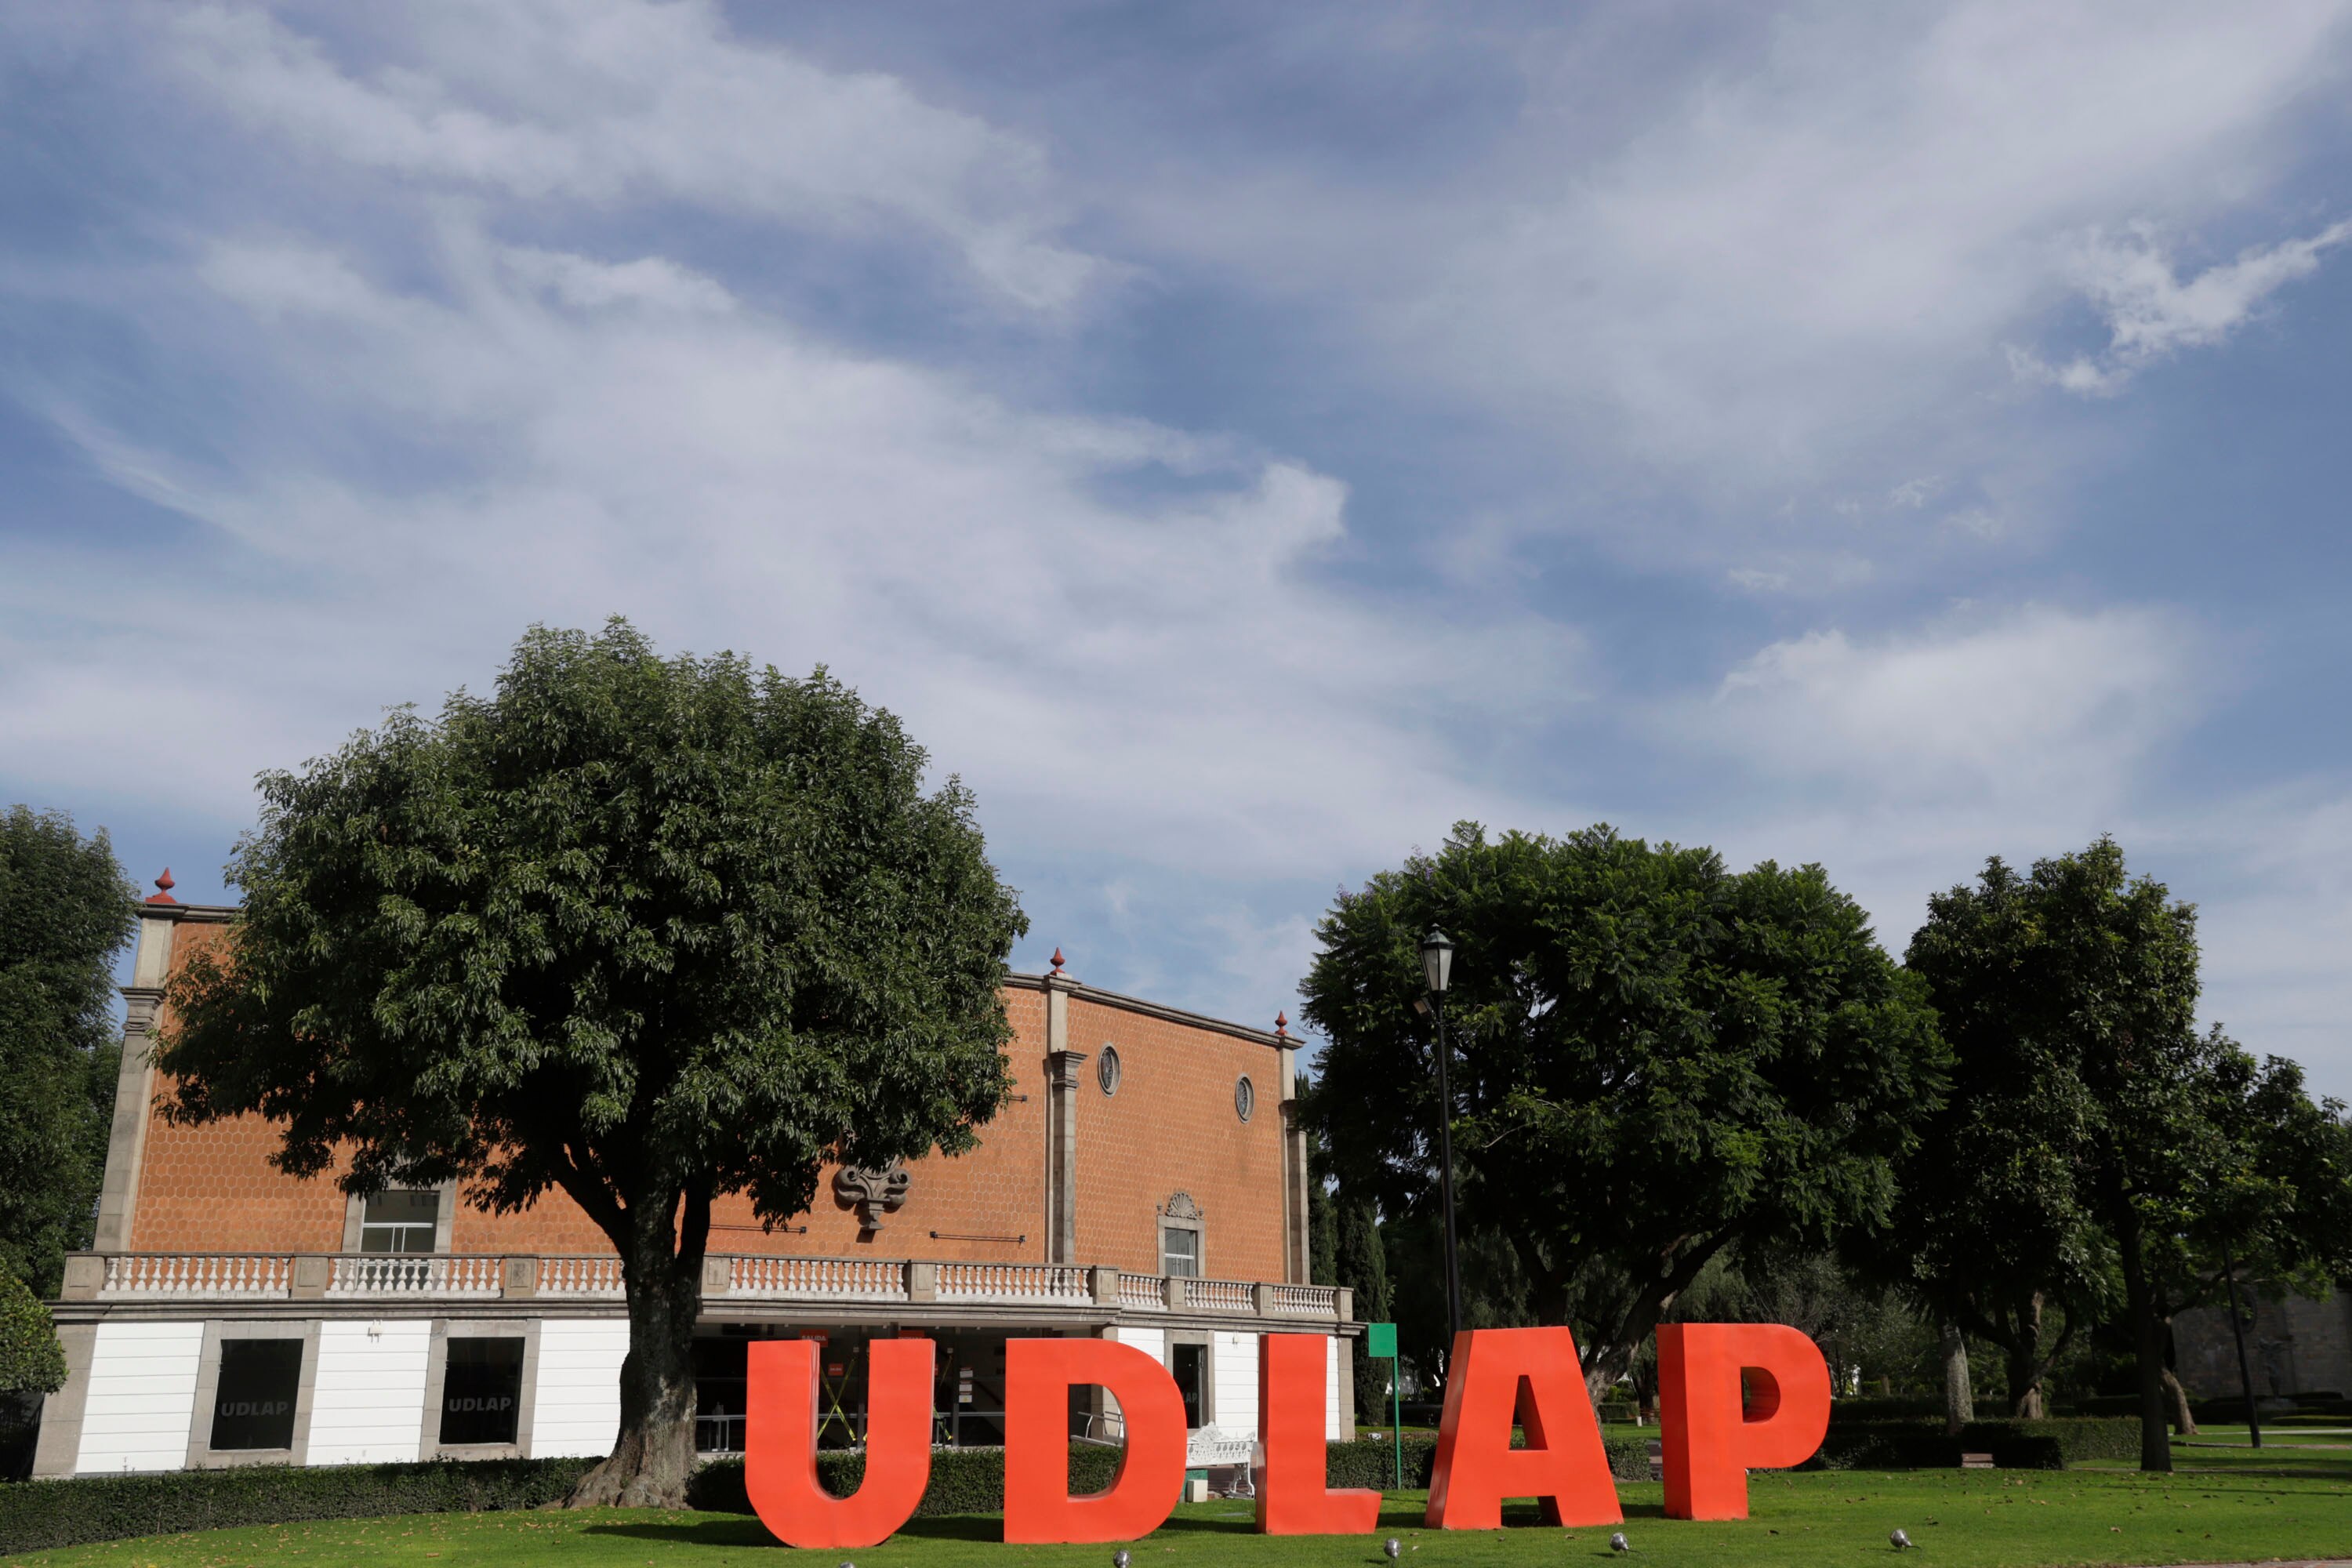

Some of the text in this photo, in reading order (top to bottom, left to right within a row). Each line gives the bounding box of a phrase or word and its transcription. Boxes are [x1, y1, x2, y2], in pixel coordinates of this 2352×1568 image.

[221, 1401, 289, 1416] UDLAP
[449, 1396, 512, 1411] UDLAP
[745, 1323, 1831, 1548] UDLAP
